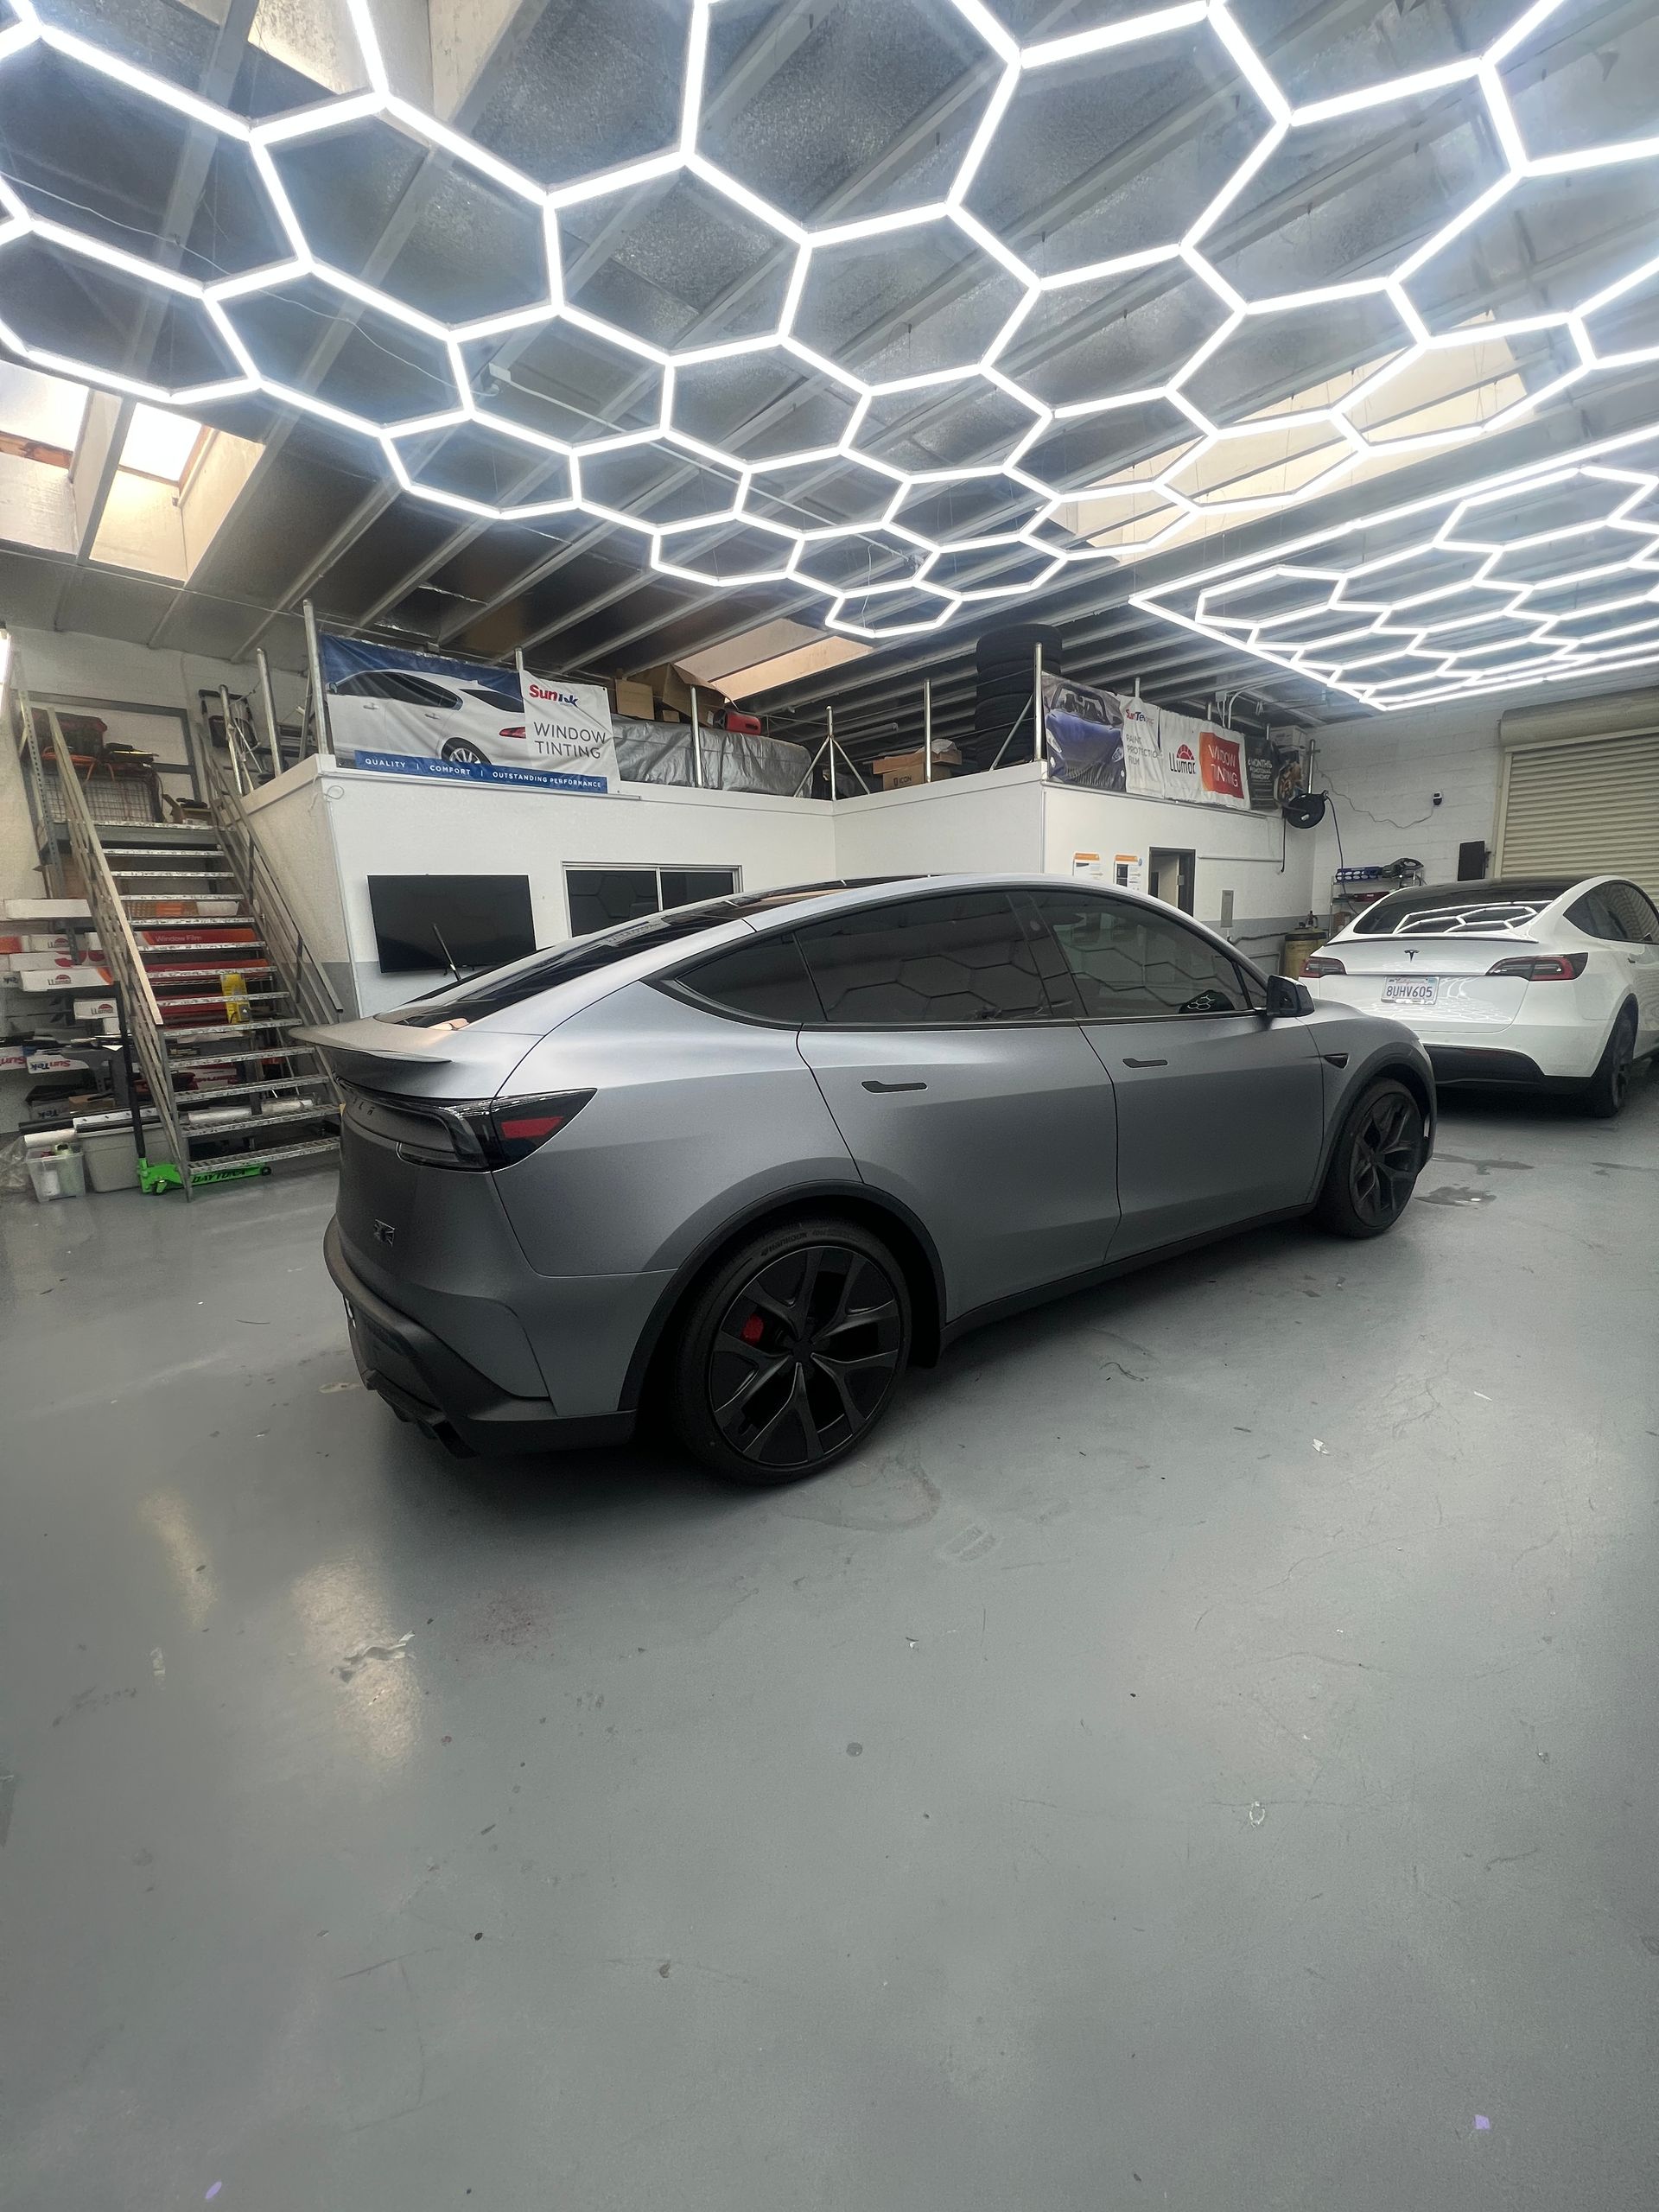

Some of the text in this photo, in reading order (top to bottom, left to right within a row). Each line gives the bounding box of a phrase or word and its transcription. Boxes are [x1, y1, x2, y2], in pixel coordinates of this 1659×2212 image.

[533, 721, 606, 745] WINDOW
[1126, 734, 1141, 744] PAINT
[534, 741, 601, 760] TINTING
[1128, 754, 1140, 766] FILM
[1168, 752, 1197, 775] LLumar
[365, 758, 602, 788] QUALITY COMFORT OUTSTANDING PERFORMANCE
[1386, 985, 1433, 998] 8UHV605
[30, 1059, 71, 1071] SunTek
